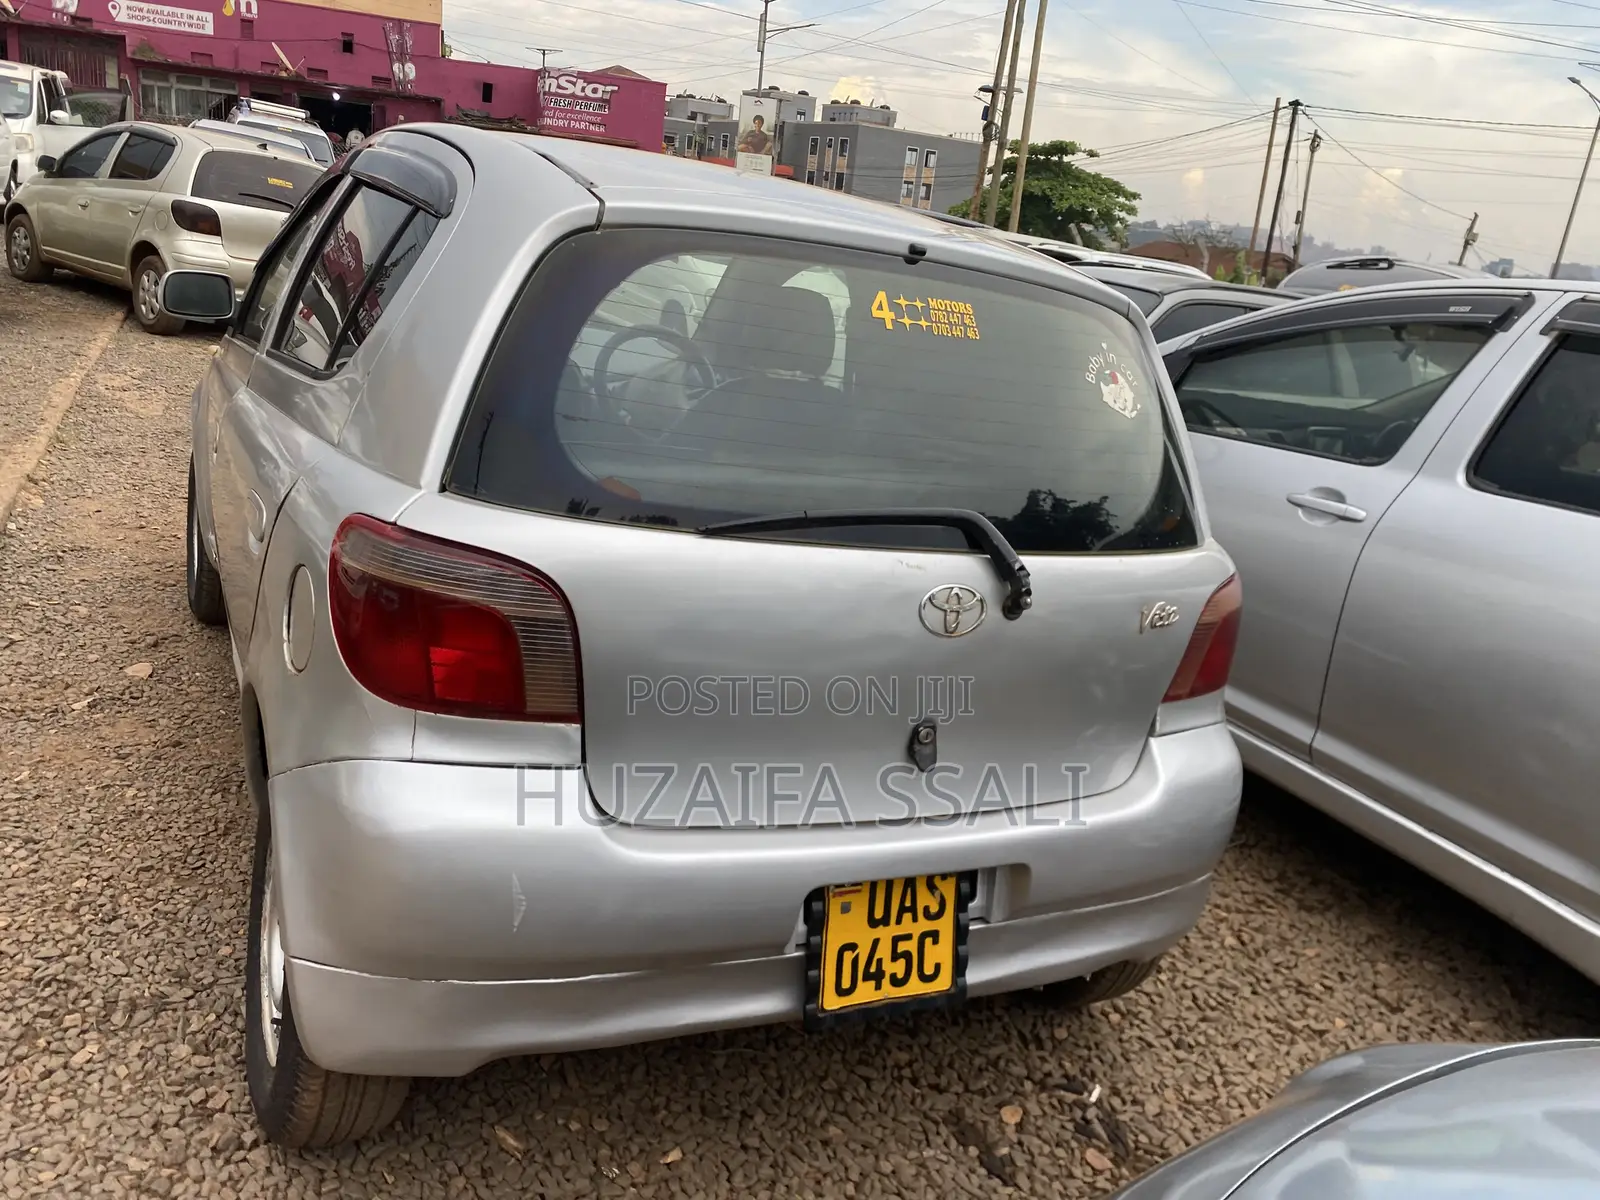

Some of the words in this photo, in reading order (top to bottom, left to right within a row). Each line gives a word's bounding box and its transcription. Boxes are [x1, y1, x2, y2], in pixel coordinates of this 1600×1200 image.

[126, 5, 144, 14] NOW
[146, 7, 185, 20] AVAILABLE
[196, 15, 210, 24] ALL
[126, 13, 151, 23] SHOPS
[152, 17, 206, 31] COUNTRYWIDE
[549, 97, 573, 109] FRESH
[574, 101, 609, 114] PERFUME
[554, 109, 566, 119] for
[566, 113, 602, 123] excellence
[570, 120, 606, 132] PARTNER
[871, 290, 896, 330] 4
[927, 297, 973, 315] MOTORS
[930, 309, 949, 324] 0782
[949, 312, 962, 325] 447
[963, 313, 977, 327] 463
[932, 322, 952, 337] 0703
[952, 325, 965, 338] 447
[966, 327, 980, 340] 463
[1085, 351, 1105, 384] Baby
[1105, 351, 1117, 365] in
[1120, 363, 1138, 387] car
[867, 874, 951, 929] UAS
[834, 929, 942, 998] 045C
